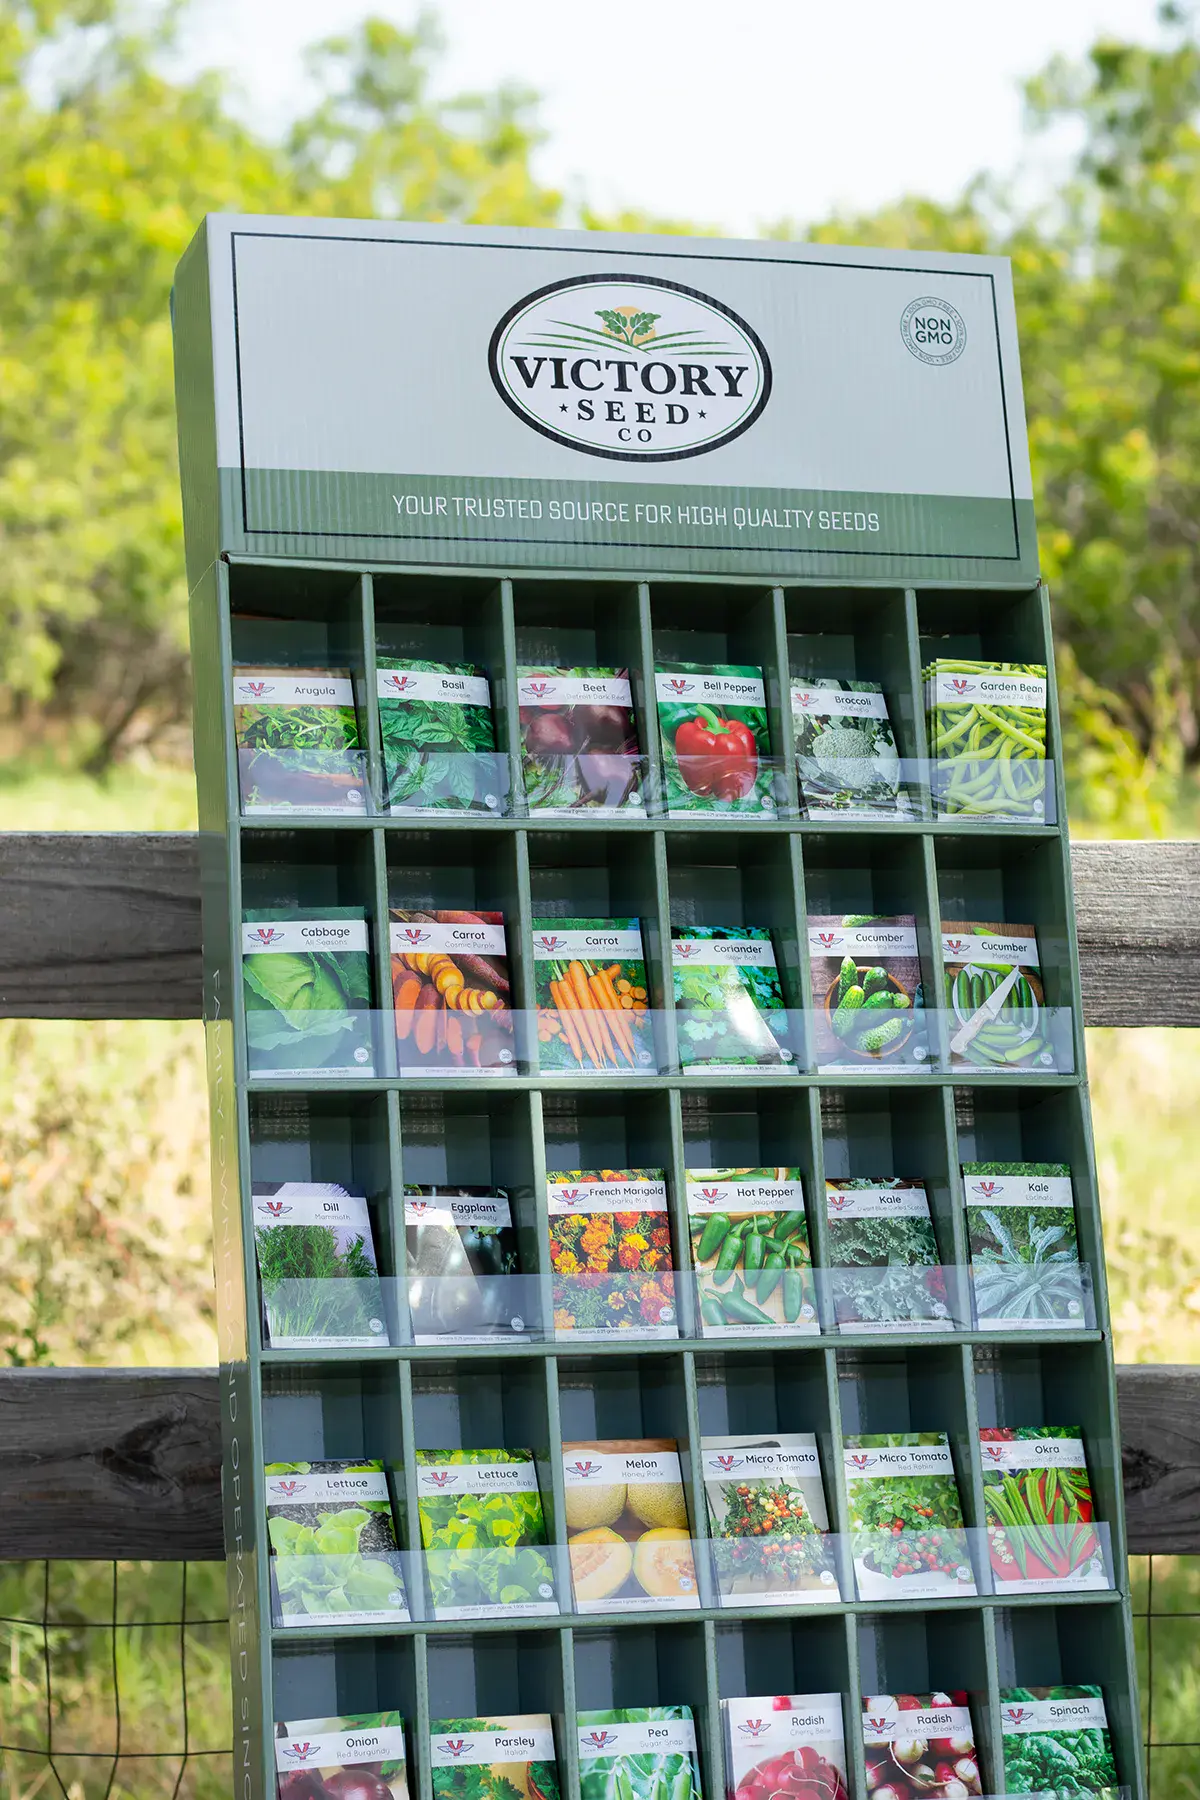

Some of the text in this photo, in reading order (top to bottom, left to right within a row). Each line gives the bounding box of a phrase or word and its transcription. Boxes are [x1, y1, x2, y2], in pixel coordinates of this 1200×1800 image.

[915, 317, 951, 331] NON
[915, 331, 953, 344] GMO
[510, 356, 748, 397] VICTORY
[577, 399, 689, 424] SEED
[618, 428, 652, 442] CO
[393, 495, 880, 531] YOUR TRUSTED SOURCE FOR HIGH QUALITY SEEDS
[441, 680, 465, 690] Basil
[582, 683, 607, 692] Beet
[703, 681, 757, 693] Bell Pepper
[980, 681, 1043, 693] Garden Bean
[294, 686, 336, 696] Arugula
[834, 696, 872, 706] Broccoli
[301, 927, 350, 938] Cabbage
[452, 930, 486, 940] Carrot
[855, 934, 904, 942] Cucumber
[585, 936, 619, 946] Carrot
[713, 944, 763, 954] Coriander
[981, 942, 1027, 952] Cucumber
[211, 969, 225, 1119] FAMILY
[589, 1186, 664, 1197] French Marigold
[737, 1188, 795, 1198] Hot Pepper
[1028, 1183, 1049, 1192] Kale
[879, 1196, 902, 1204] Kale
[323, 1202, 339, 1212] Dill
[451, 1202, 497, 1214] Eggplant
[218, 1134, 233, 1311] OWNED
[227, 1324, 239, 1423] AND
[1034, 1445, 1060, 1454] Okra
[746, 1454, 816, 1464] Micro Tomato
[880, 1452, 949, 1463] Micro Tomato
[626, 1459, 658, 1468] Melon
[478, 1470, 518, 1480] Lettuce
[327, 1480, 368, 1489] Lettuce
[229, 1436, 248, 1682] OPERATED
[1049, 1704, 1090, 1716] Spinach
[792, 1716, 825, 1727] Radish
[917, 1714, 952, 1725] Radish
[648, 1728, 669, 1738] Pea
[346, 1736, 379, 1748] Onion
[494, 1737, 536, 1748] Parsley
[336, 1748, 391, 1759] Red Burgundy
